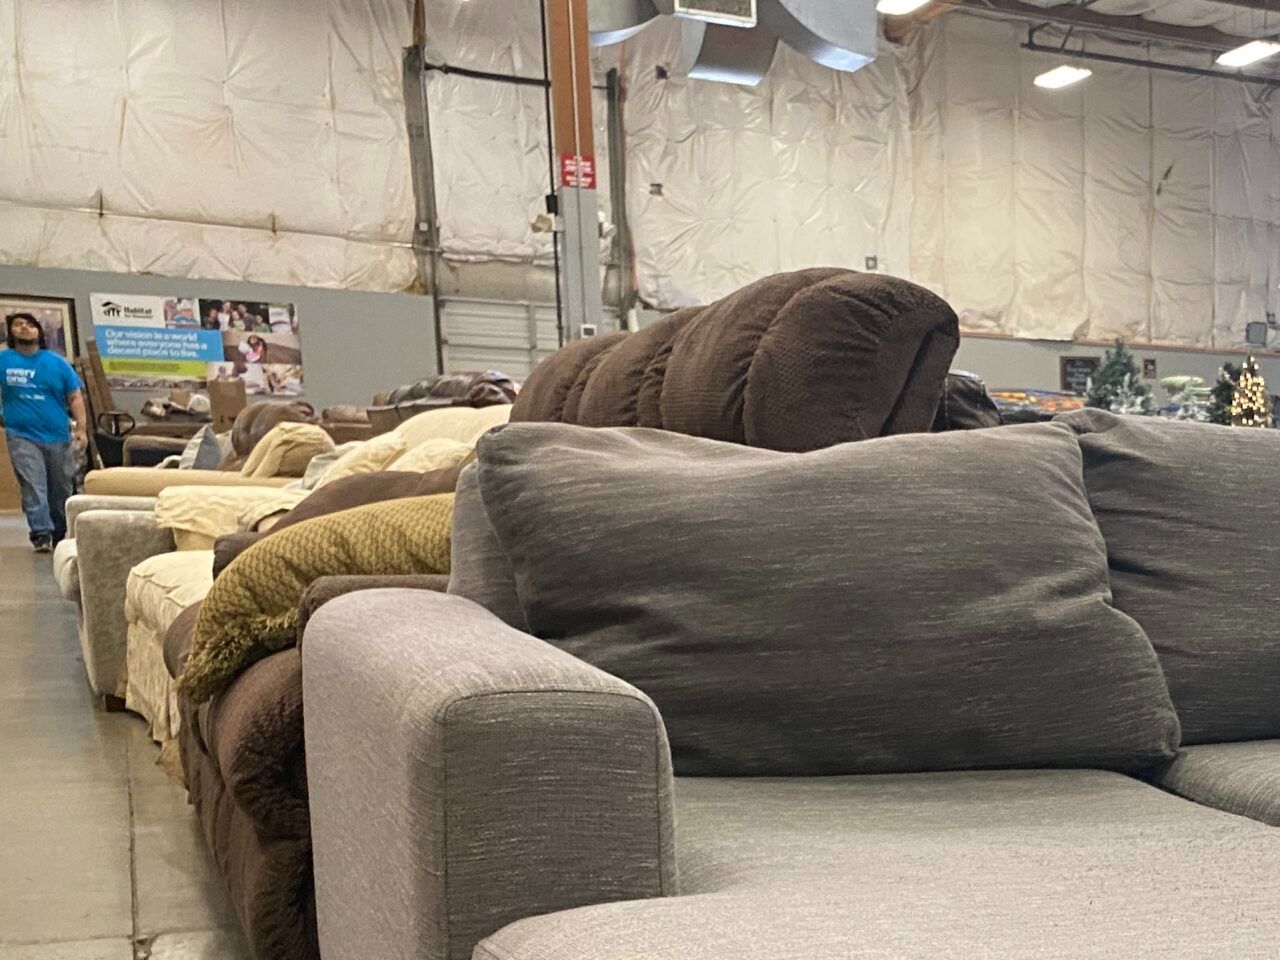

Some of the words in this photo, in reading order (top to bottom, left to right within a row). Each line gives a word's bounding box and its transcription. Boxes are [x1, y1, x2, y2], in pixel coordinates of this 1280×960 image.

[105, 329, 122, 338] Our
[125, 331, 153, 339] vision
[171, 332, 198, 341] world
